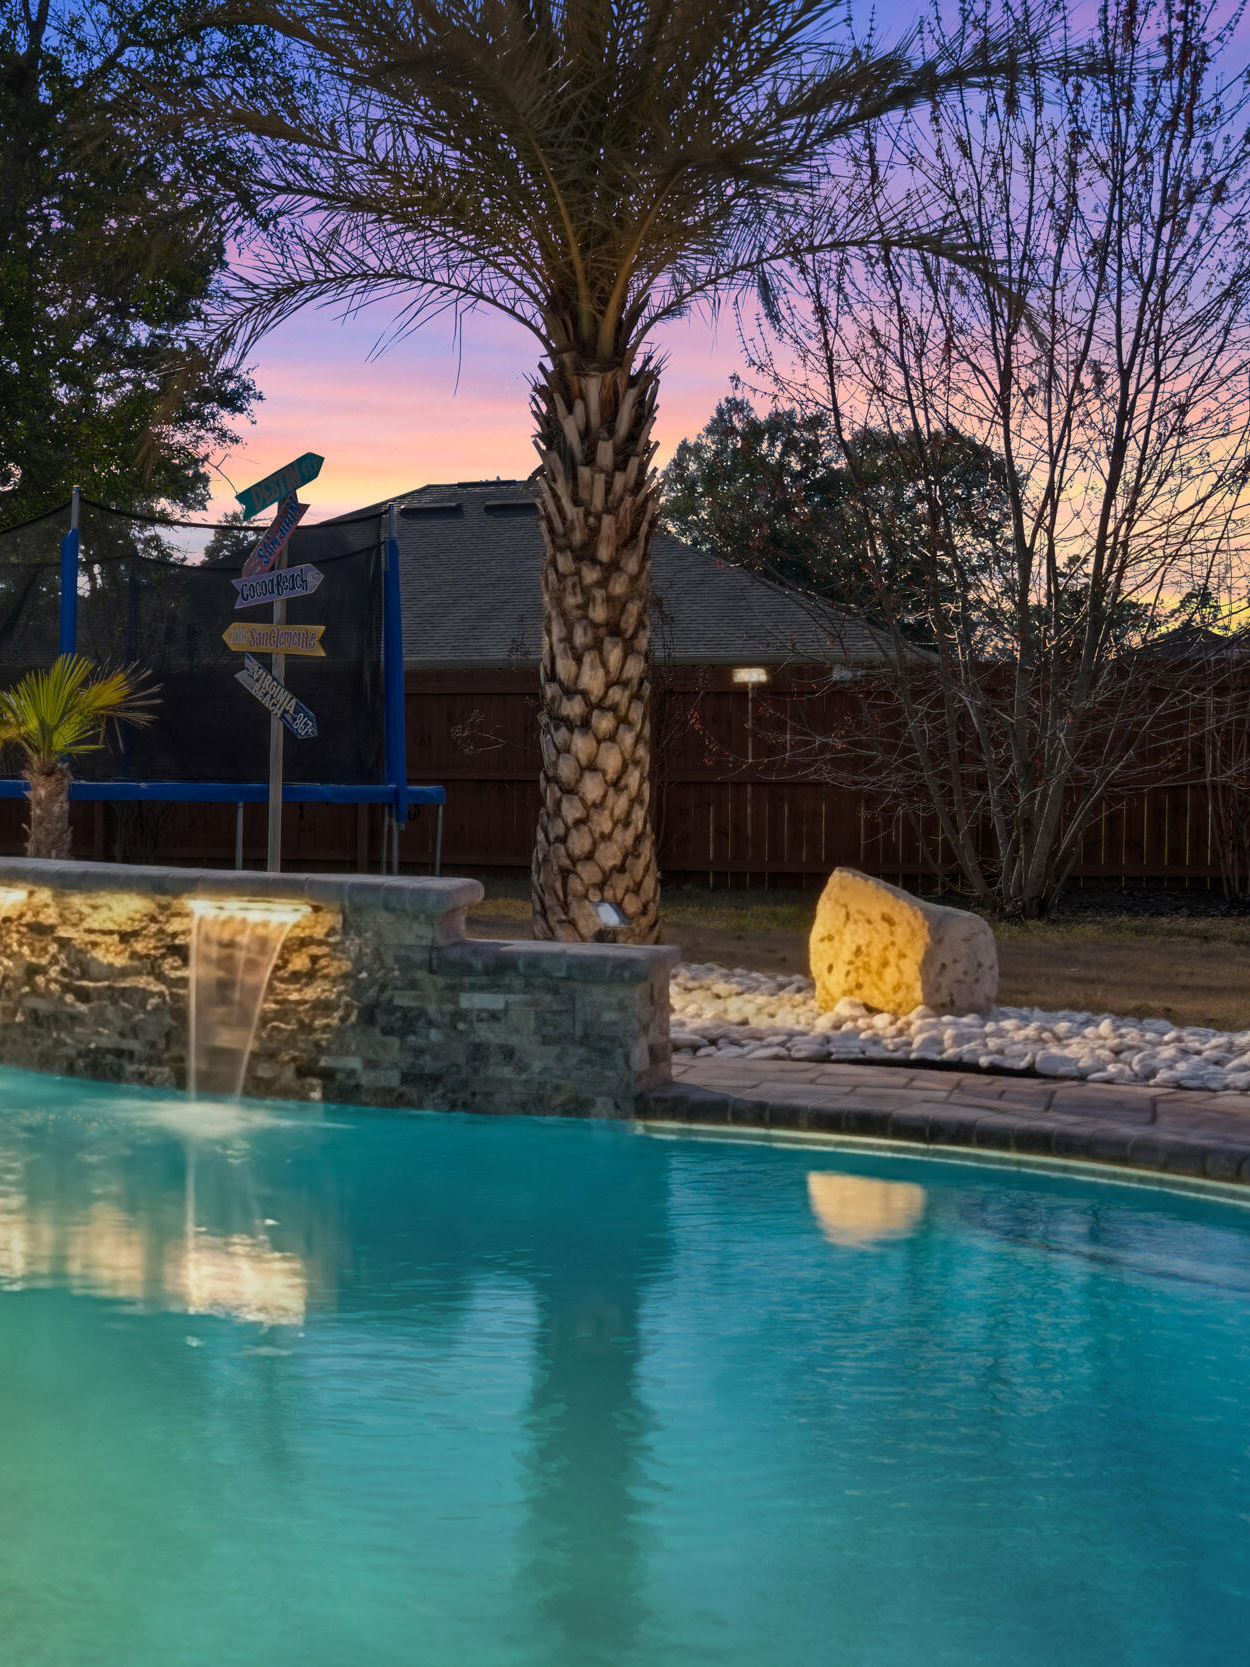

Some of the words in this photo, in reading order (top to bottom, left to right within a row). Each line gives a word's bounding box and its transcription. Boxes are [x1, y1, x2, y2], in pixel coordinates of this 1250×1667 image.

[251, 460, 303, 511] DESTIN
[240, 579, 275, 602] Cocoa
[275, 568, 308, 597] Beach
[252, 684, 285, 720] BEACH
[253, 663, 298, 715] VIRGINIA
